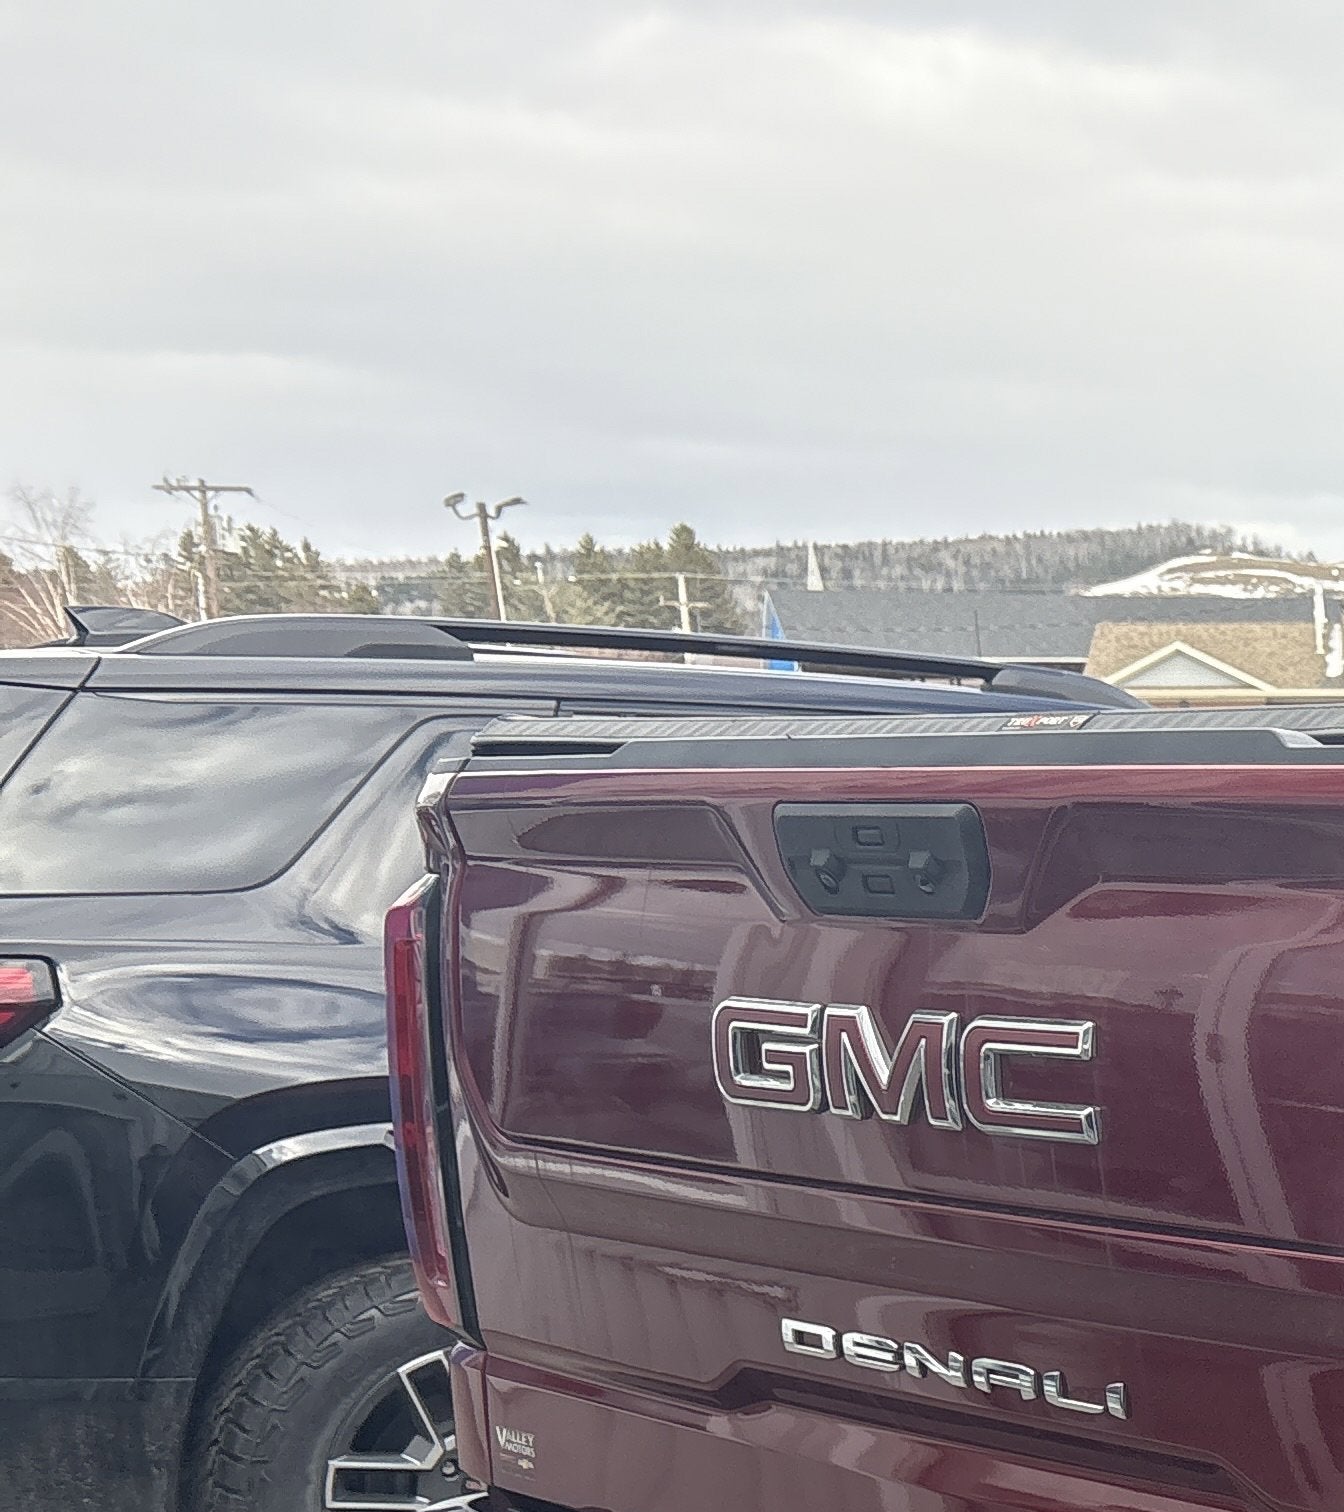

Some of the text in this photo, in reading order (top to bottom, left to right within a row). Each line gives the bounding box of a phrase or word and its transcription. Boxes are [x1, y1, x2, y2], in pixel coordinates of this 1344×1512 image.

[711, 996, 1102, 1146] GMC
[781, 1316, 1130, 1420] DENALI
[495, 1425, 535, 1447] VALLEY
